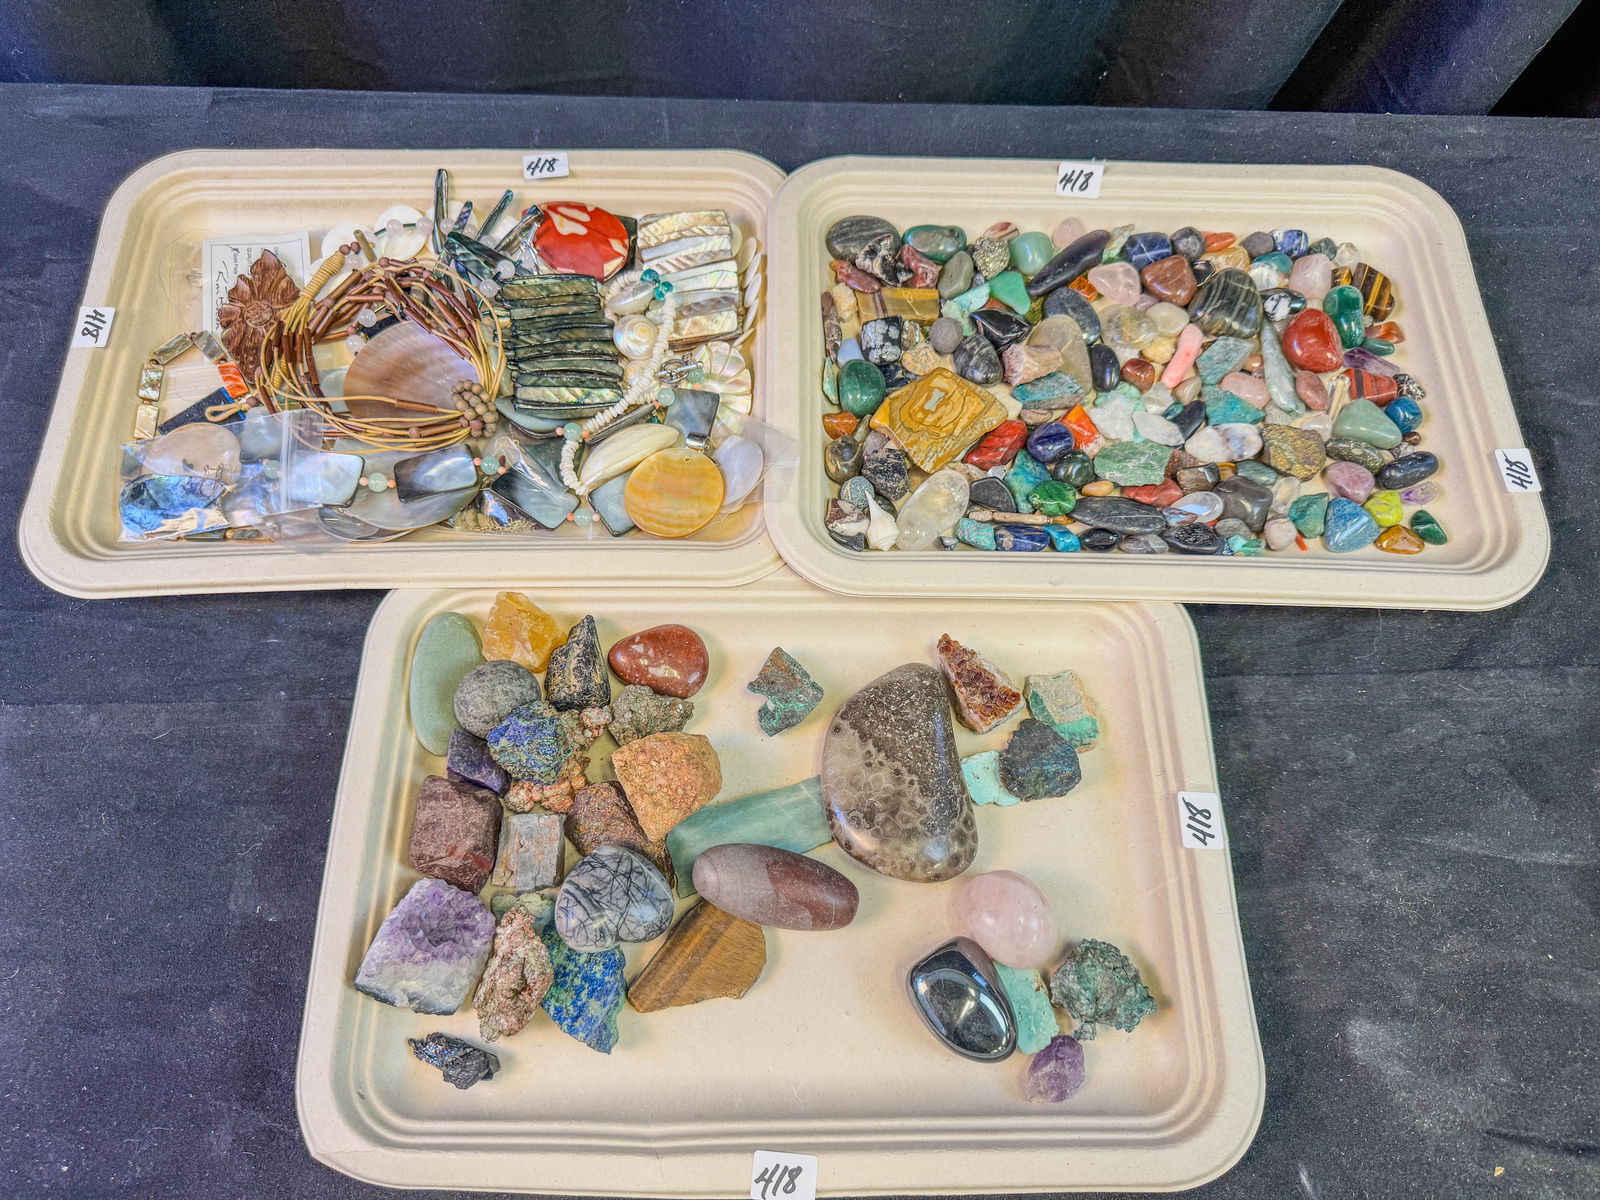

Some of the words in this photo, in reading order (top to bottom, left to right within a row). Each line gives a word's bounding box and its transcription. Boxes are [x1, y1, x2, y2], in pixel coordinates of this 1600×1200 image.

[526, 157, 560, 177] 418
[1058, 169, 1094, 193] 418
[81, 309, 108, 344] 418
[1501, 450, 1534, 490] 418
[1181, 796, 1216, 847] 418
[753, 1162, 804, 1200] 418
